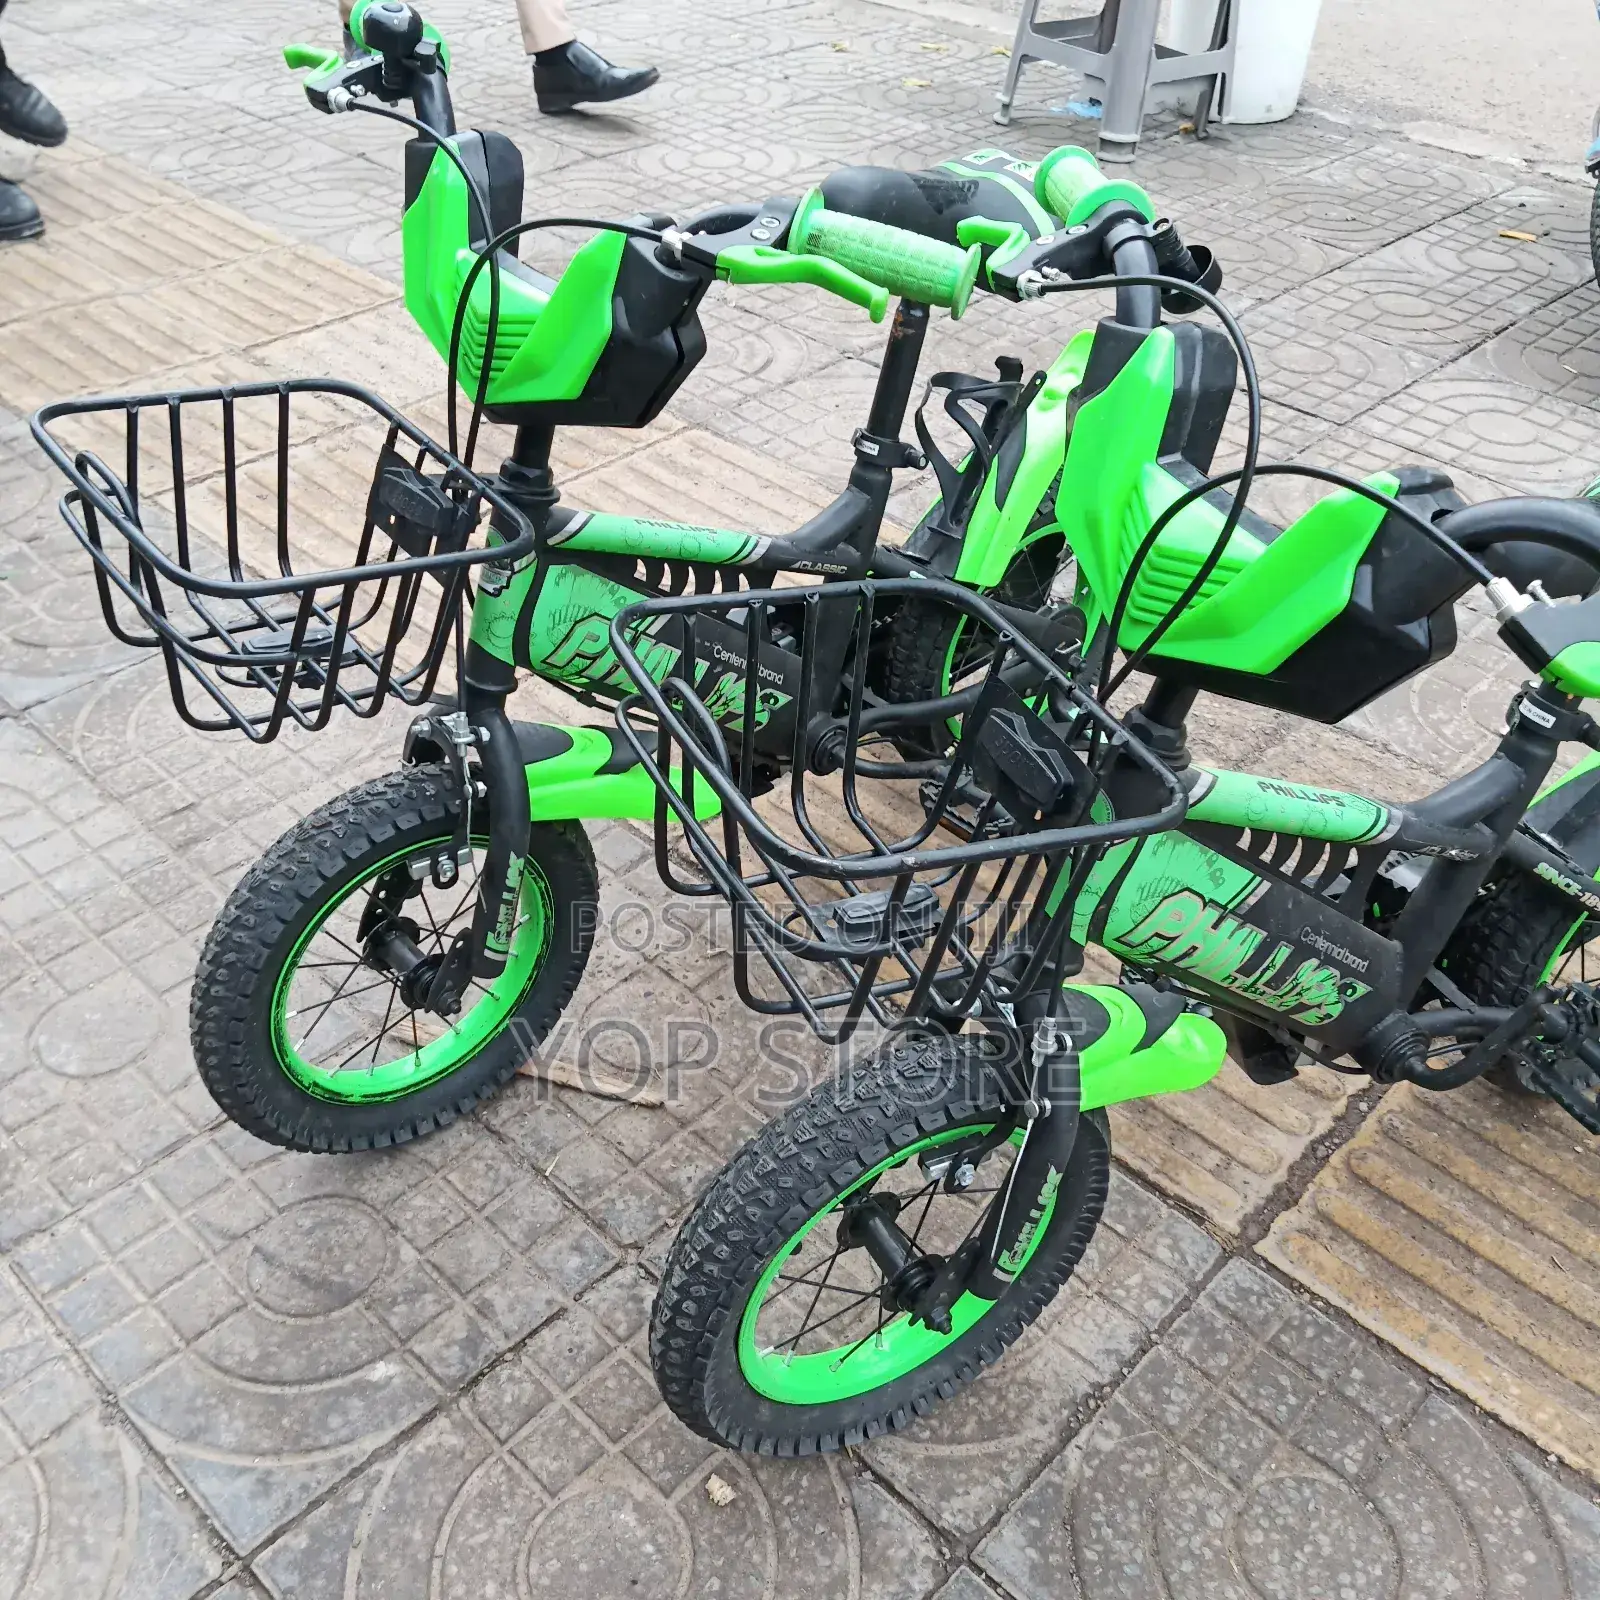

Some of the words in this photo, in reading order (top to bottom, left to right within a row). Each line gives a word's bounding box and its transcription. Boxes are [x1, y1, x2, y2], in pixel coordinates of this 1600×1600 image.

[799, 560, 848, 575] CLASSIC
[758, 662, 784, 686] brand
[1256, 780, 1346, 808] PHILLIPS
[1118, 888, 1374, 1027] PHILLIPS
[1301, 926, 1346, 961] Centennial
[1342, 949, 1369, 973] brand
